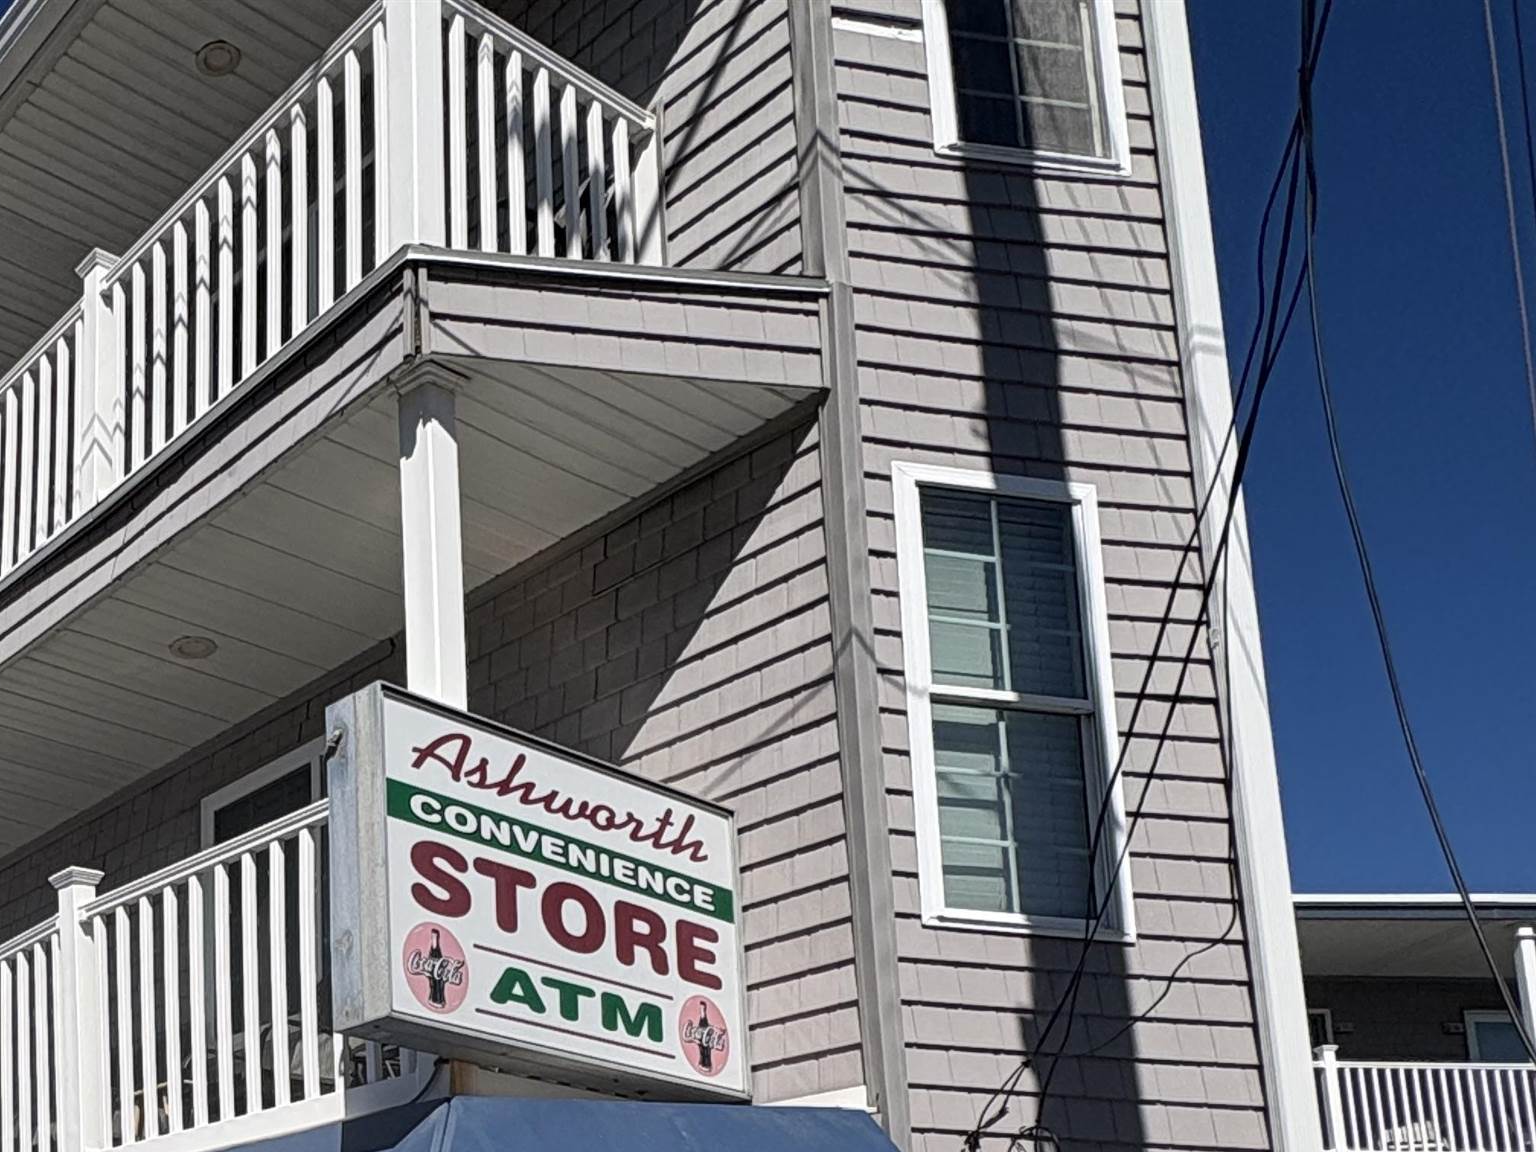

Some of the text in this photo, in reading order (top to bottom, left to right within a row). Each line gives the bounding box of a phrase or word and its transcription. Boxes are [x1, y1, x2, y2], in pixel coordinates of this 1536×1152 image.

[409, 794, 716, 912] CONVENIENCE
[410, 732, 709, 863] Ashworth
[409, 840, 723, 991] STORE
[489, 966, 665, 1043] ATM
